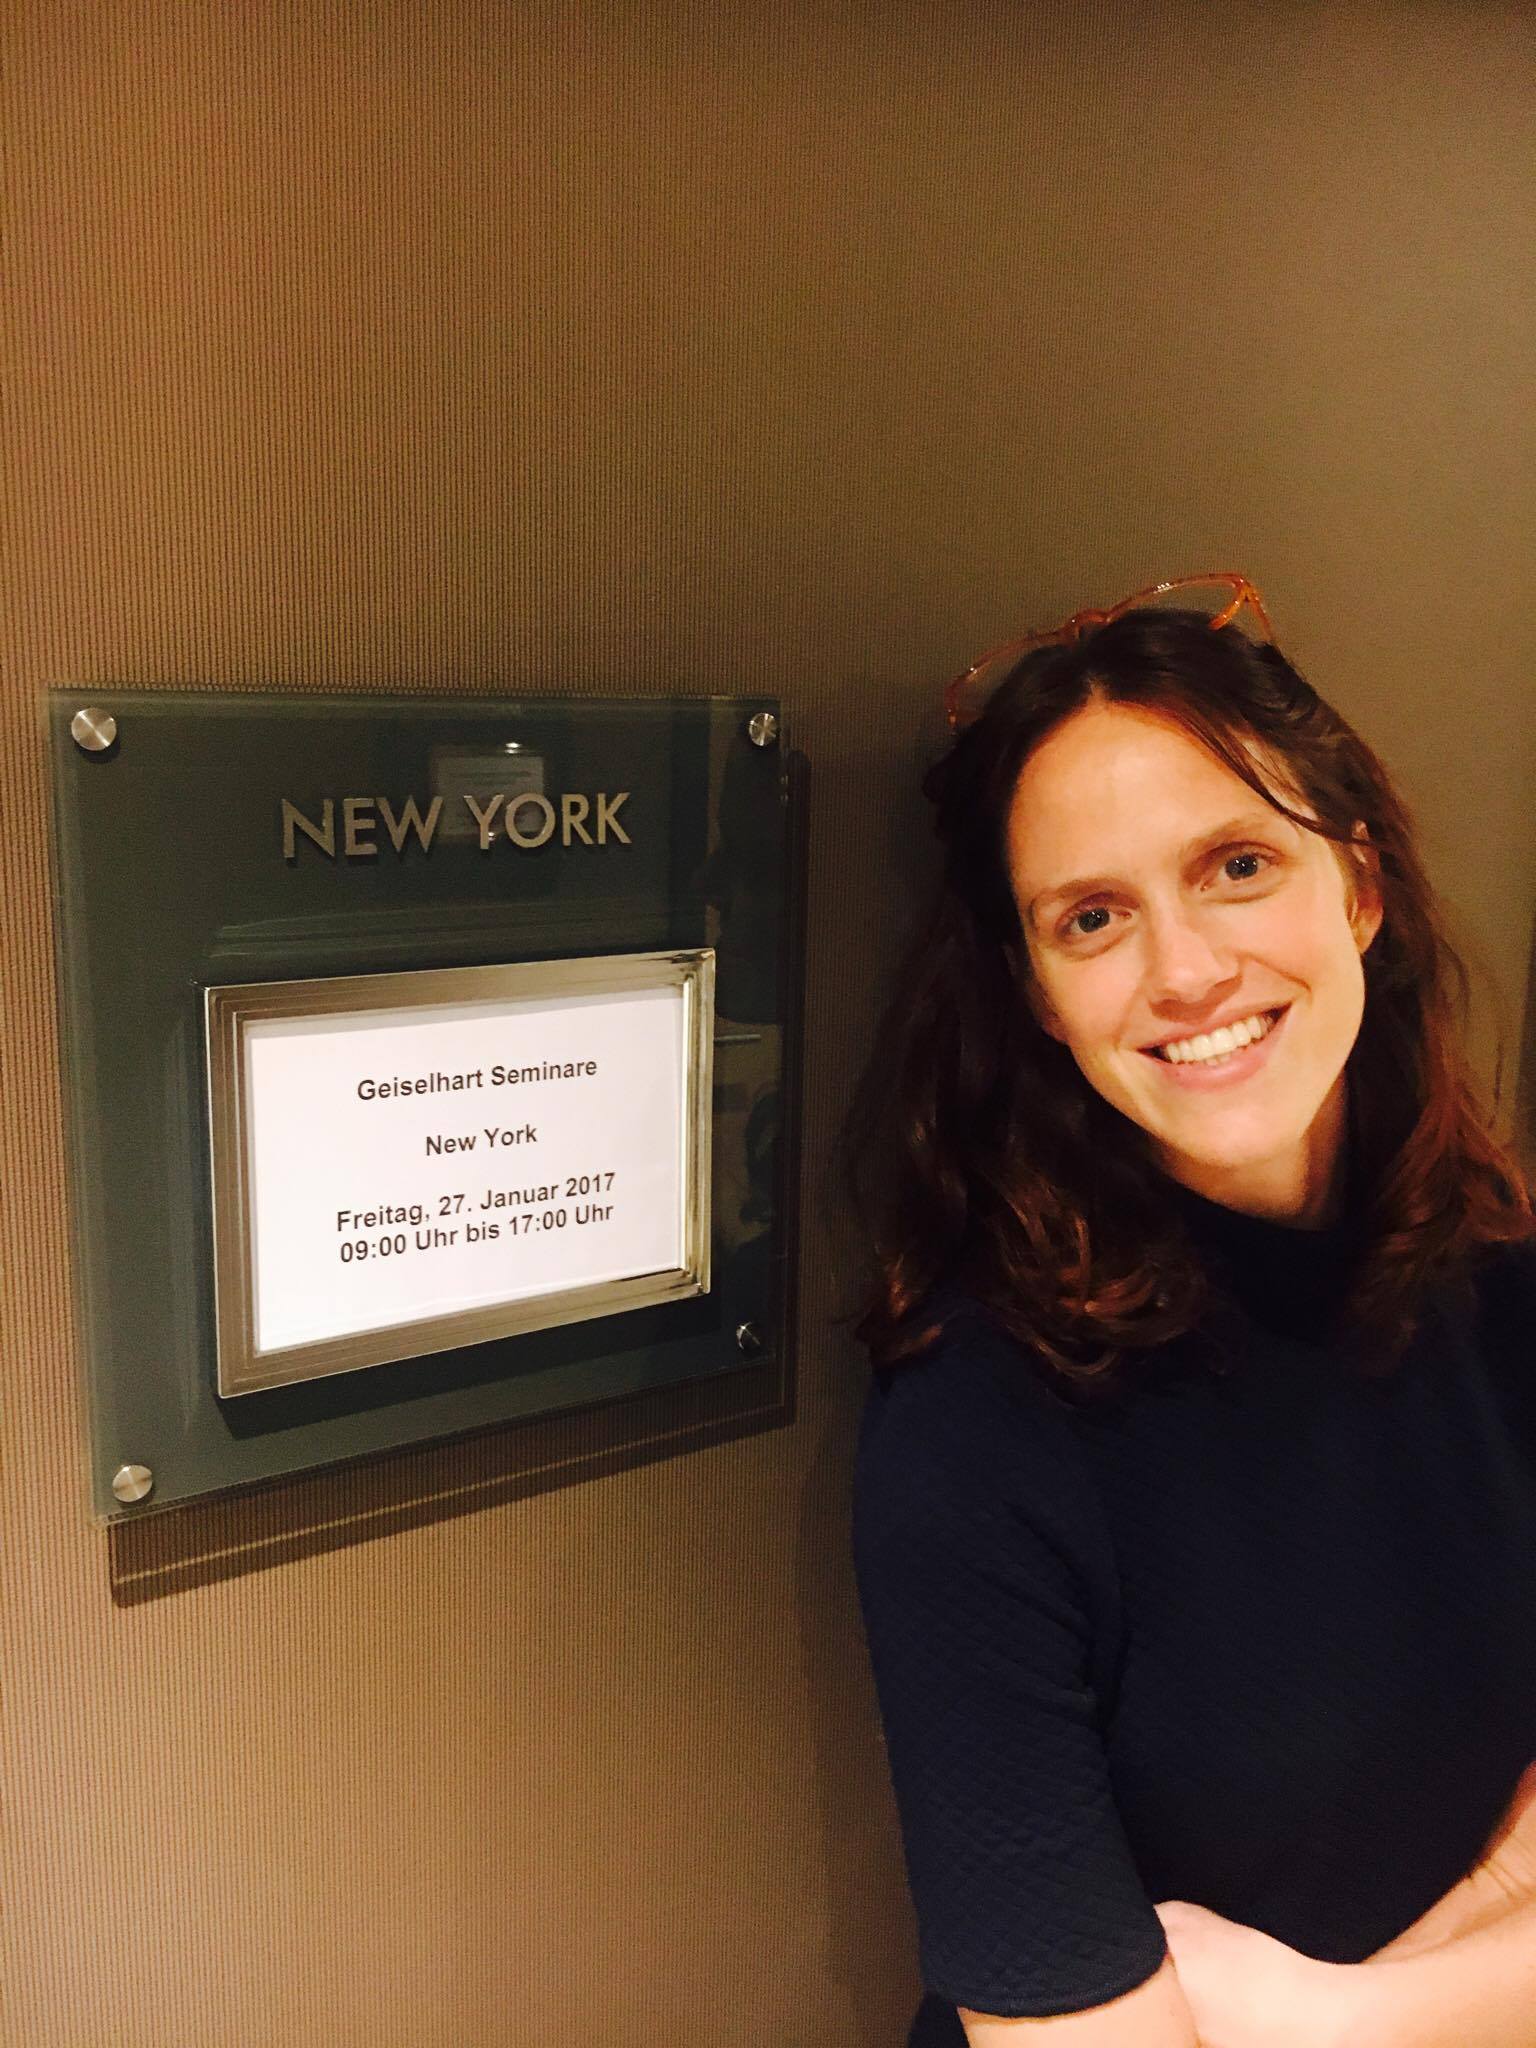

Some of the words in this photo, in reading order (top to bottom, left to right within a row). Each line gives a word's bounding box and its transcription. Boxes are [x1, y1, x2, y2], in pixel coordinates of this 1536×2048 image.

[281, 795, 443, 858] NEW
[463, 791, 632, 850] YORK
[357, 1069, 483, 1101] Geiselhart
[491, 1060, 598, 1086] Seminare
[426, 1135, 477, 1156] New
[484, 1124, 538, 1148] York
[336, 1204, 430, 1232] Freitag,
[438, 1193, 472, 1216] 27.
[479, 1184, 560, 1210] Januar
[565, 1172, 616, 1198] 2017
[340, 1233, 407, 1263] 09:00
[415, 1228, 459, 1251] Uhr
[466, 1221, 500, 1243] bis
[508, 1208, 568, 1235] 17:00
[575, 1204, 614, 1225] Uhr
